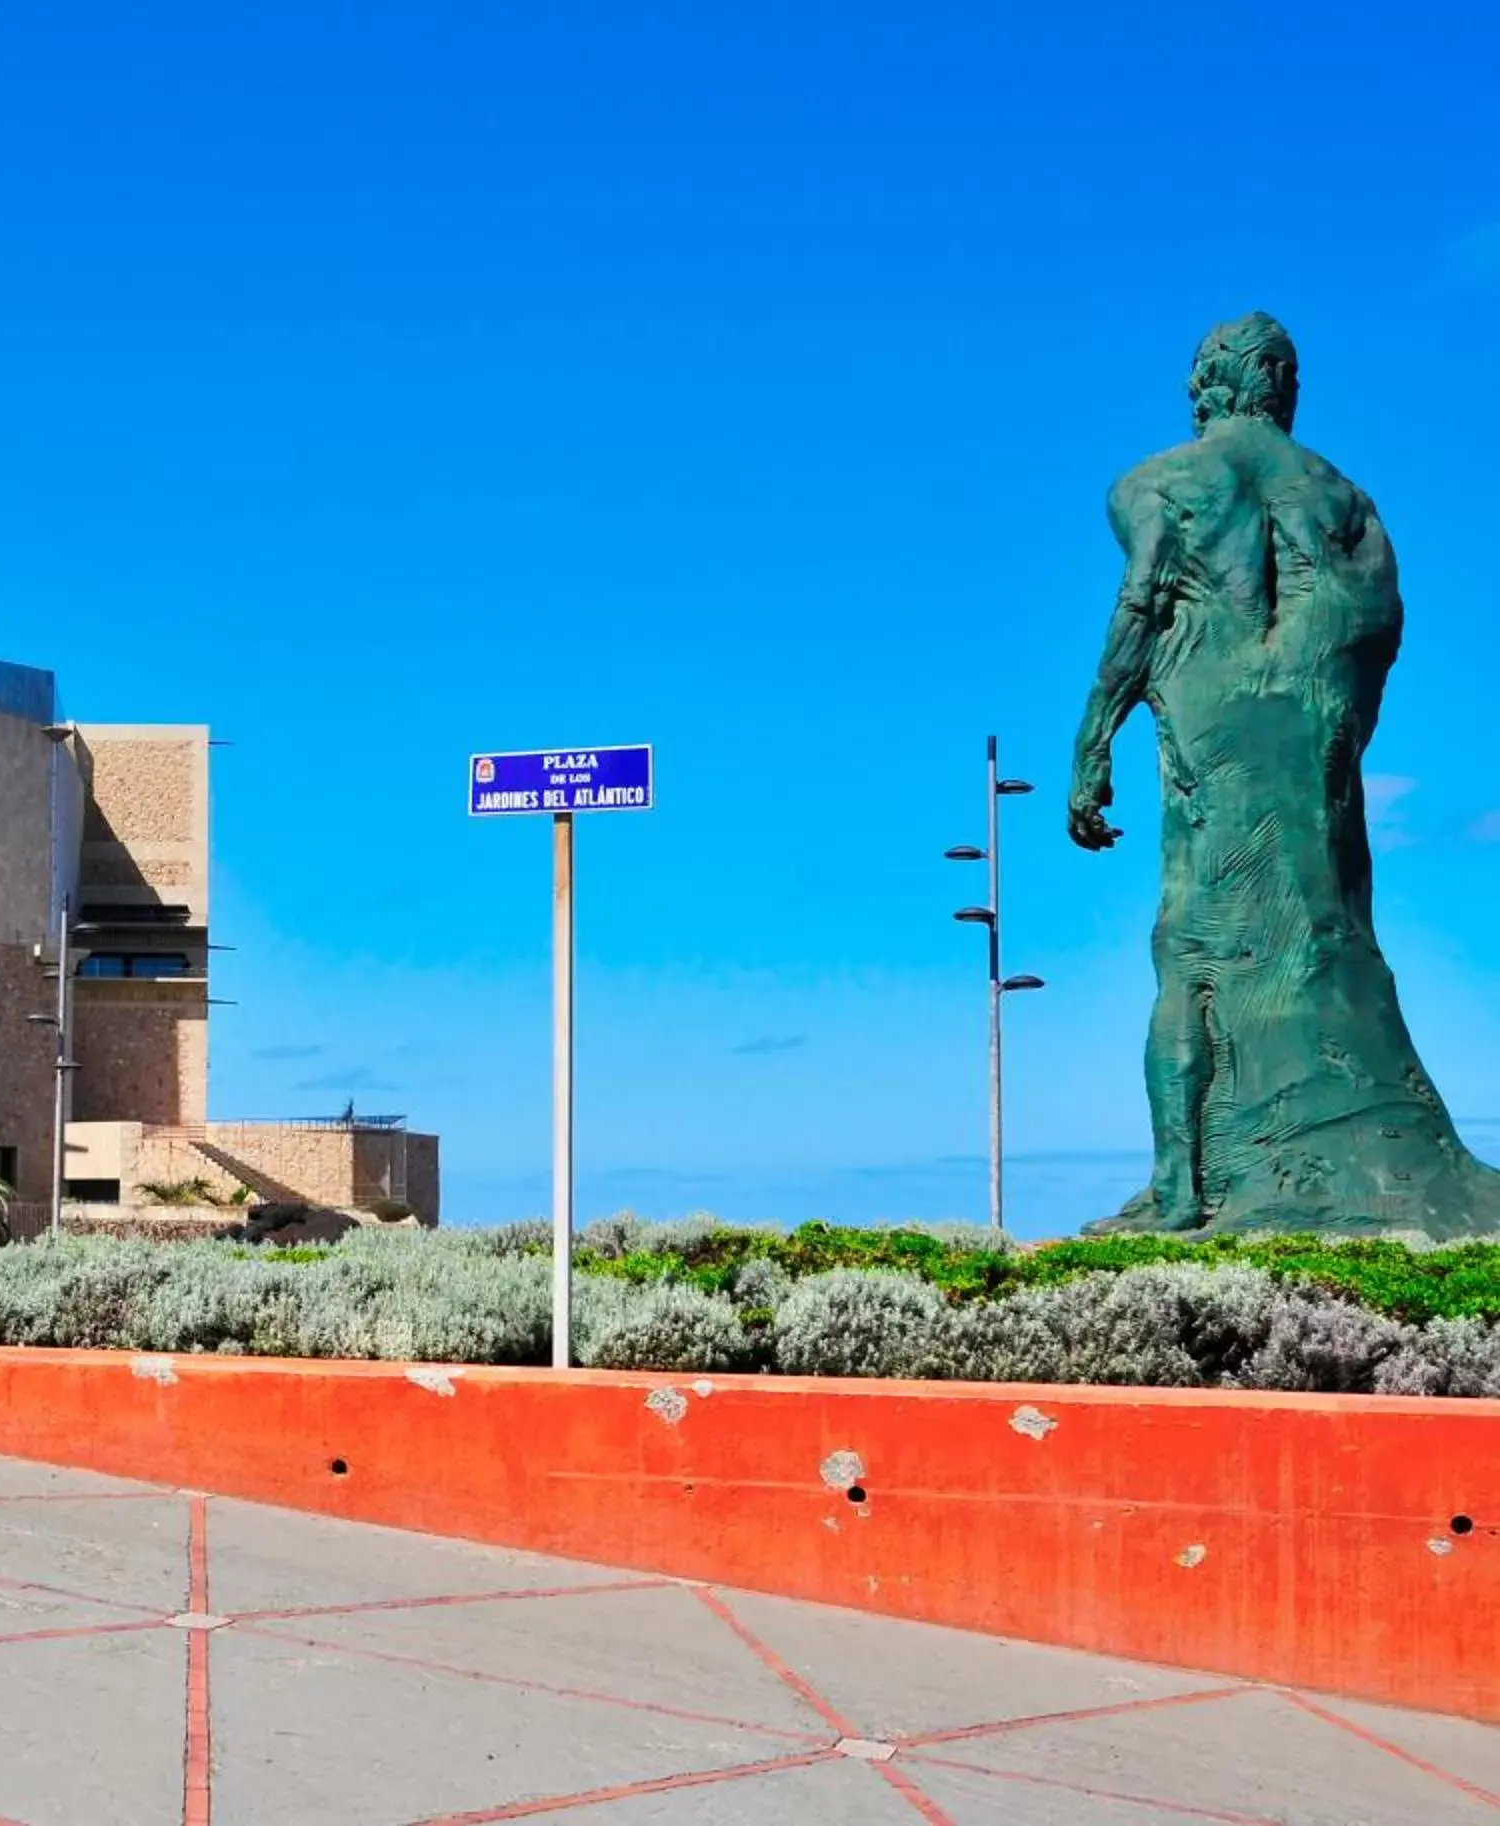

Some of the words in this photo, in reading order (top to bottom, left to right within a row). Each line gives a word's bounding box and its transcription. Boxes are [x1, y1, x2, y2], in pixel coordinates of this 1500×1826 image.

[543, 753, 599, 770] PLAZA
[550, 774, 566, 784] DE
[569, 772, 591, 783] LOS
[476, 790, 538, 810] JARDINES
[544, 789, 568, 807] DEL
[573, 785, 644, 806] ATLÁNTICO
